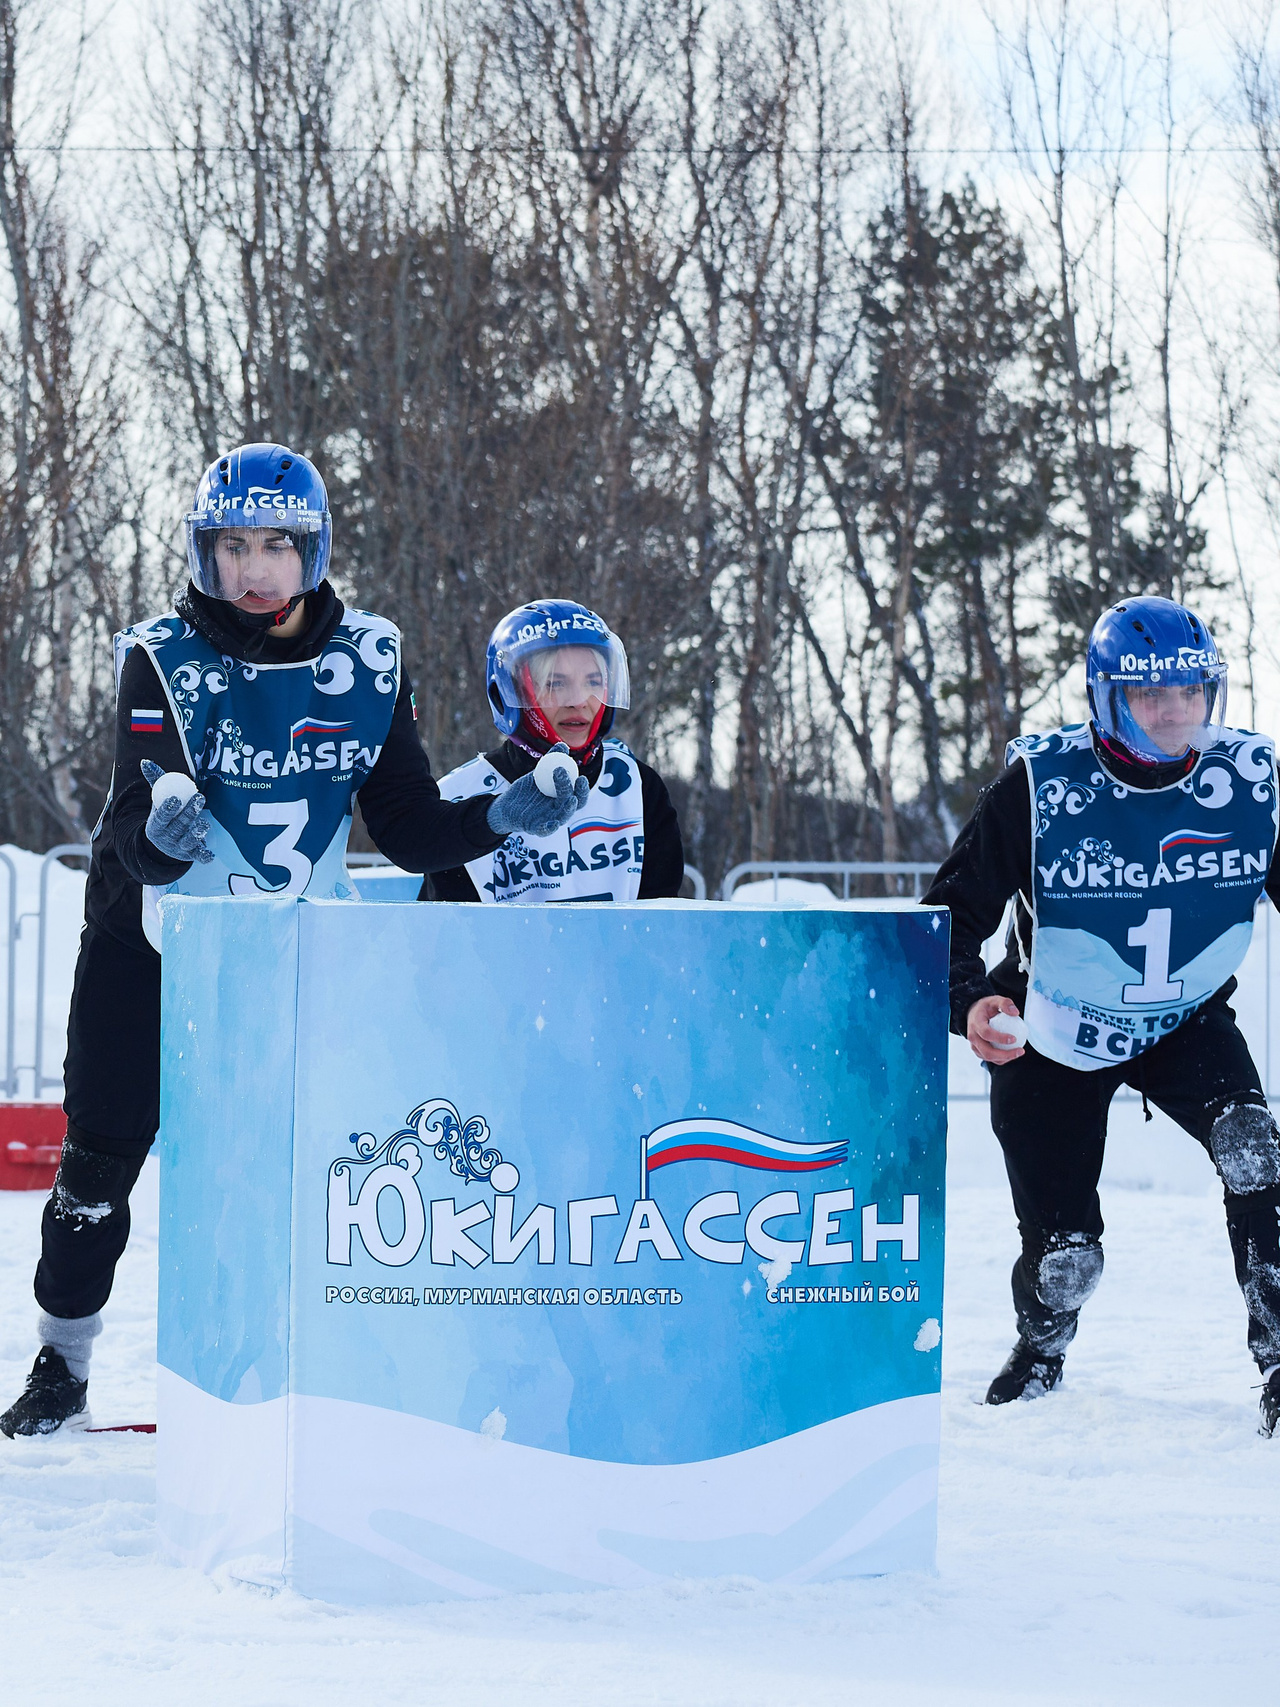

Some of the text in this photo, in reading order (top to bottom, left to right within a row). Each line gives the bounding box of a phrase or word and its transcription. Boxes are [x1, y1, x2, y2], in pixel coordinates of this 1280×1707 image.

[517, 617, 605, 641] ЮКИГАСС
[228, 798, 313, 896] 3
[1213, 878, 1252, 889] СНЕЖНЫЙ
[1122, 907, 1183, 1004] 1
[1080, 1012, 1102, 1023] КТО
[1109, 1015, 1136, 1027] ТЕХ,
[1076, 1022, 1100, 1049] В
[326, 1155, 920, 1269] ЮКИГАССЕН
[325, 1286, 683, 1307] РОССИЯ, МУРМАНСКАЯ ОБЛАСТЬ
[766, 1280, 920, 1304] СНЕЖНЫЙ БОЙ
